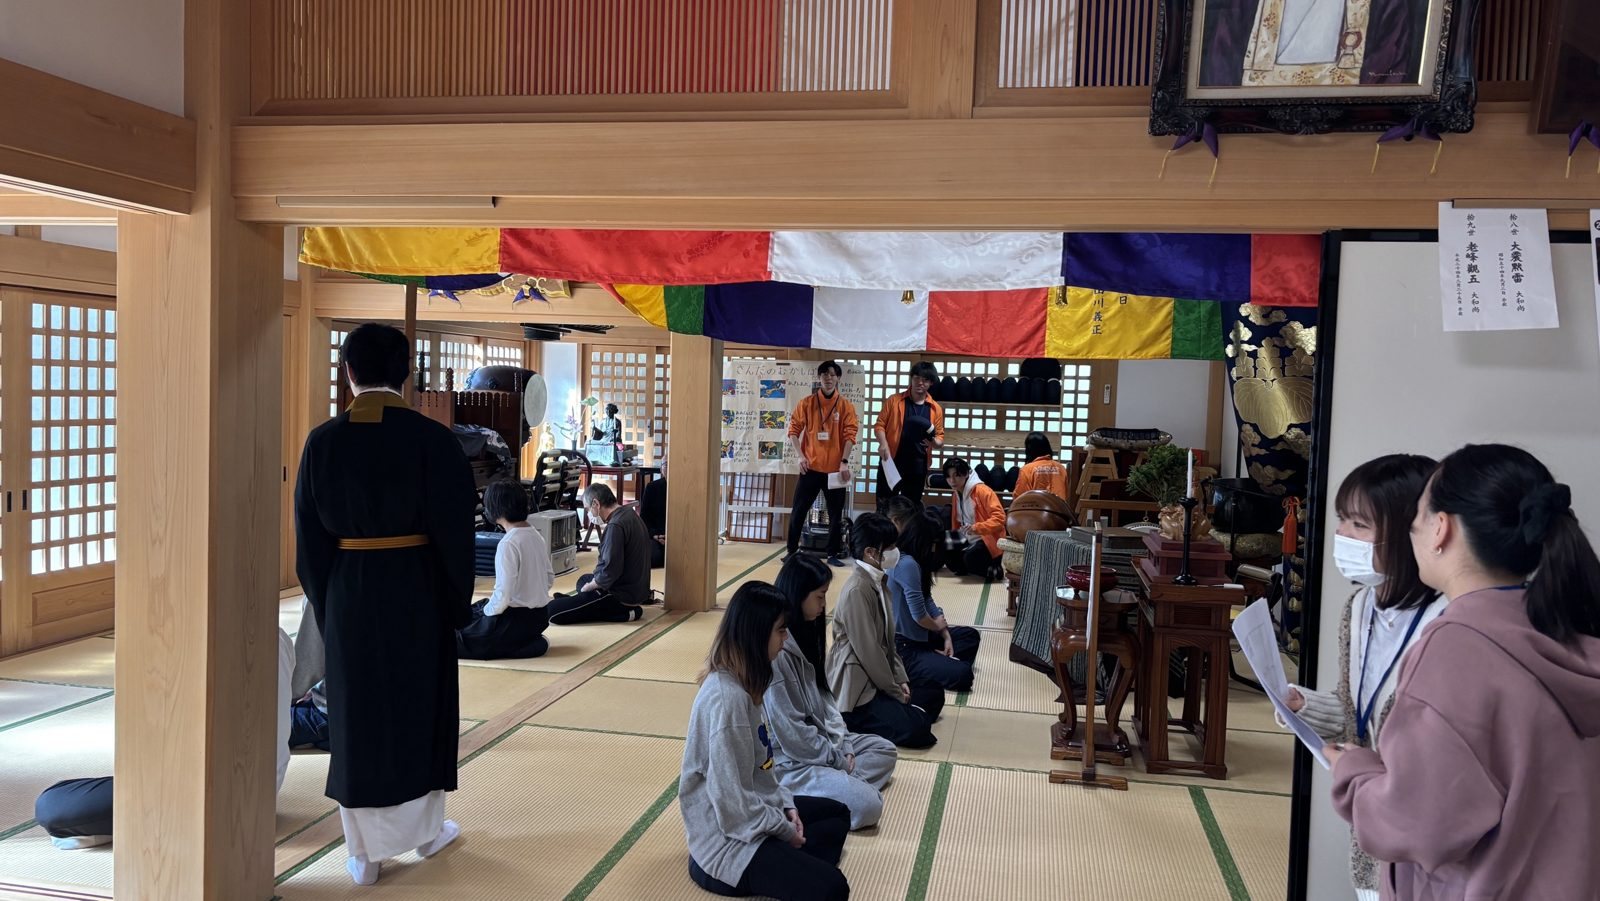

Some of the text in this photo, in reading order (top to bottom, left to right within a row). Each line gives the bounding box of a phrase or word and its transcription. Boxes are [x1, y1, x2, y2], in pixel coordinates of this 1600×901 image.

[1471, 292, 1480, 313] 大和尚
[1516, 291, 1525, 312] 大和尚
